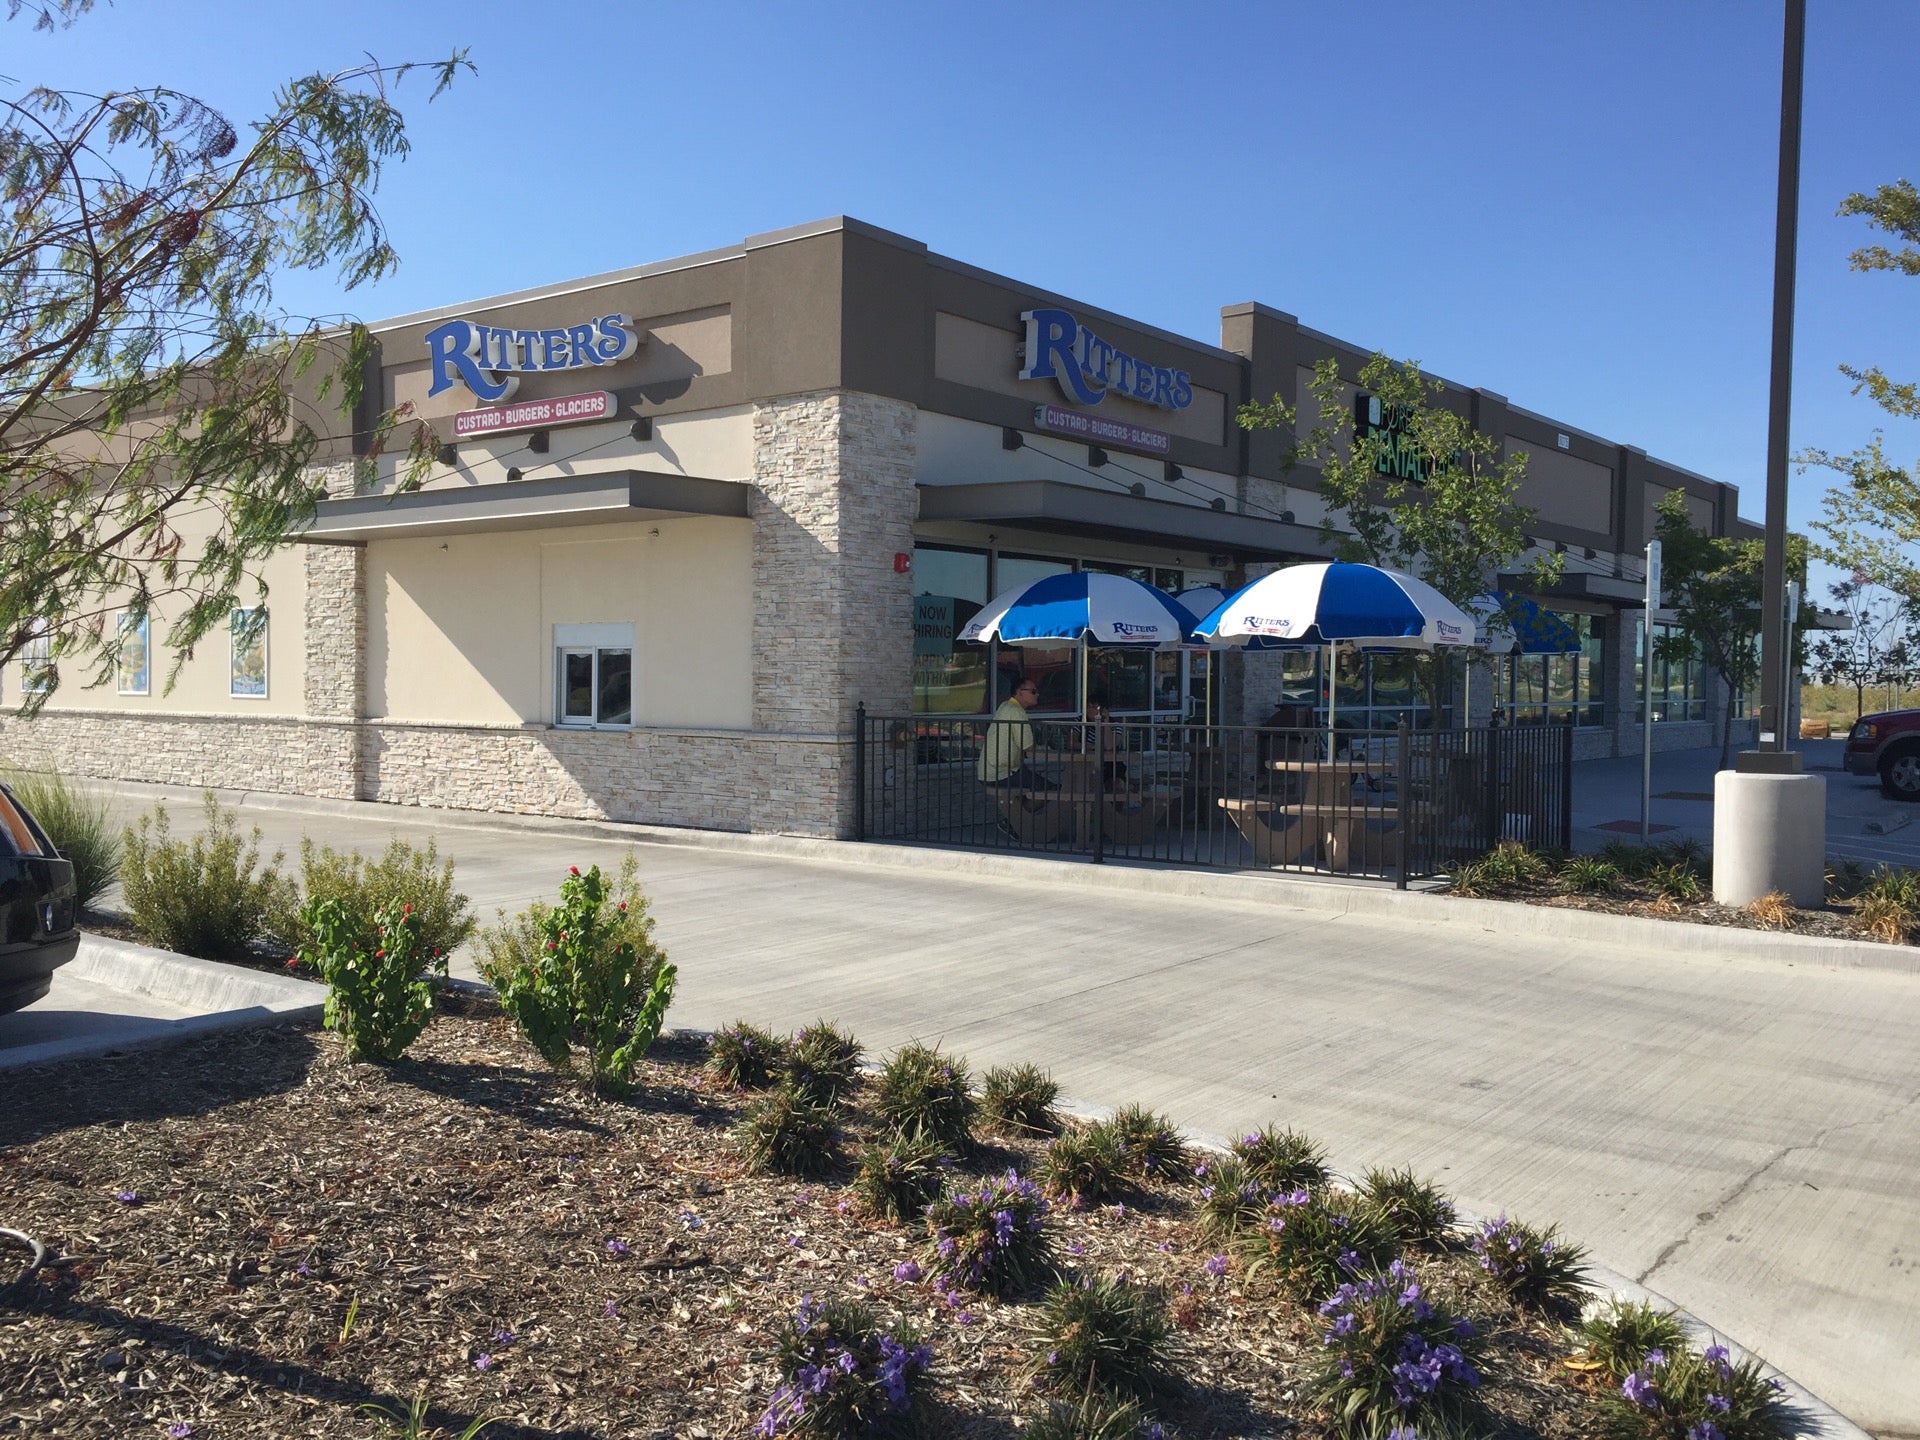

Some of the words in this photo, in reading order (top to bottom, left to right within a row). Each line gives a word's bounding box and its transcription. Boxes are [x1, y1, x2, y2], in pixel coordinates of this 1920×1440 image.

[425, 313, 630, 401] RITTER'S
[1022, 309, 1193, 410] RITTER'S
[457, 412, 501, 431] CUSTARD
[505, 406, 551, 425] BURGERS
[555, 397, 605, 417] GLACIERS
[1047, 410, 1088, 431] CUSTARD
[1091, 423, 1128, 440] BURGERS
[1131, 428, 1167, 449] GLACIERS
[914, 623, 952, 639] HIRING
[919, 606, 947, 620] NOW
